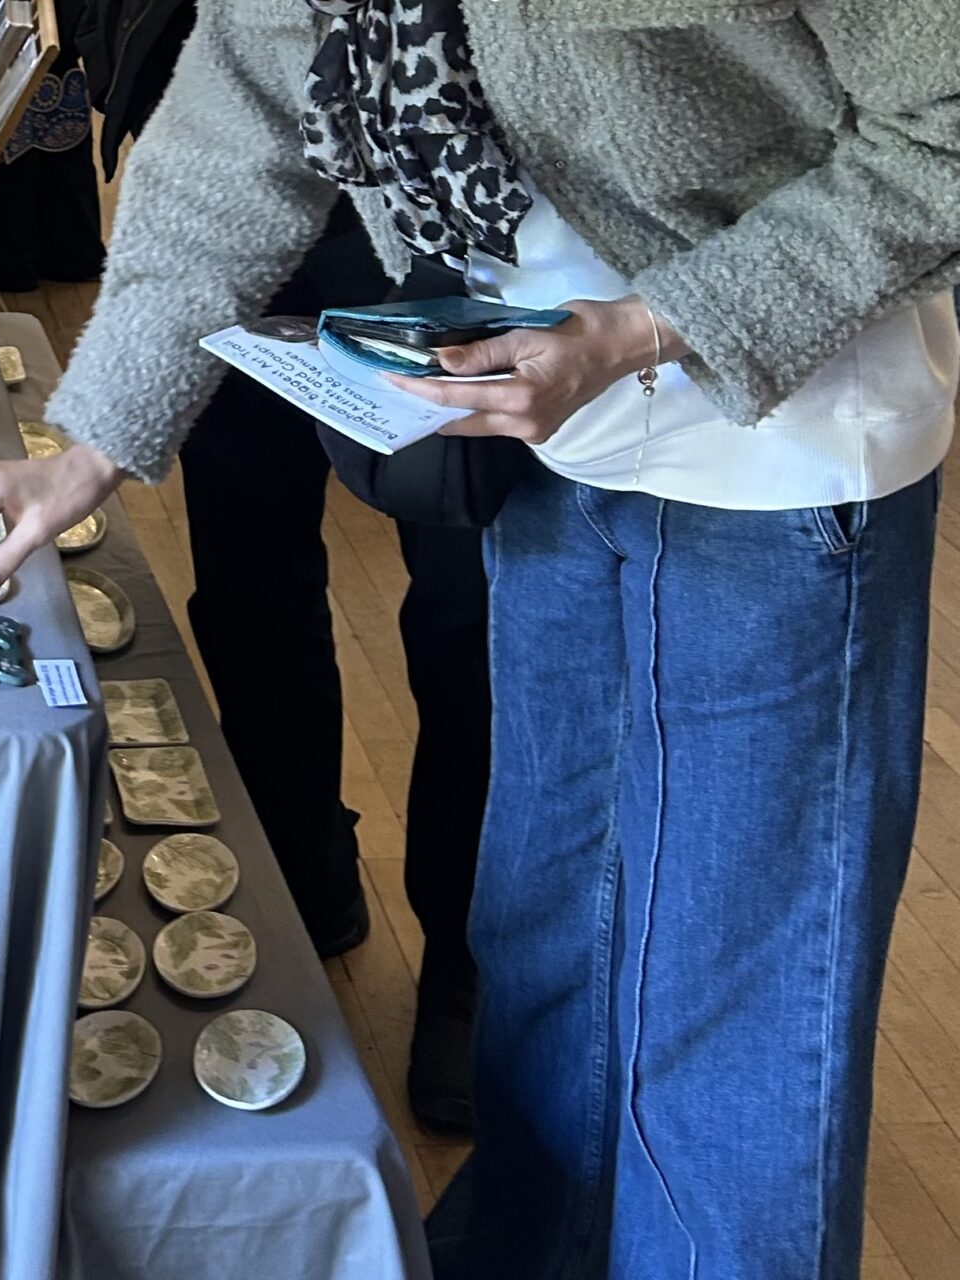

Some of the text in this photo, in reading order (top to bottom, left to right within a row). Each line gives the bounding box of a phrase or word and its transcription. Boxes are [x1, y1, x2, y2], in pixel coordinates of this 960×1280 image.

[222, 340, 399, 440] Birmingham's Biggest Art Trail
[253, 344, 390, 425] 170 Artists and Groups
[285, 351, 382, 409] Across 86 Venues
